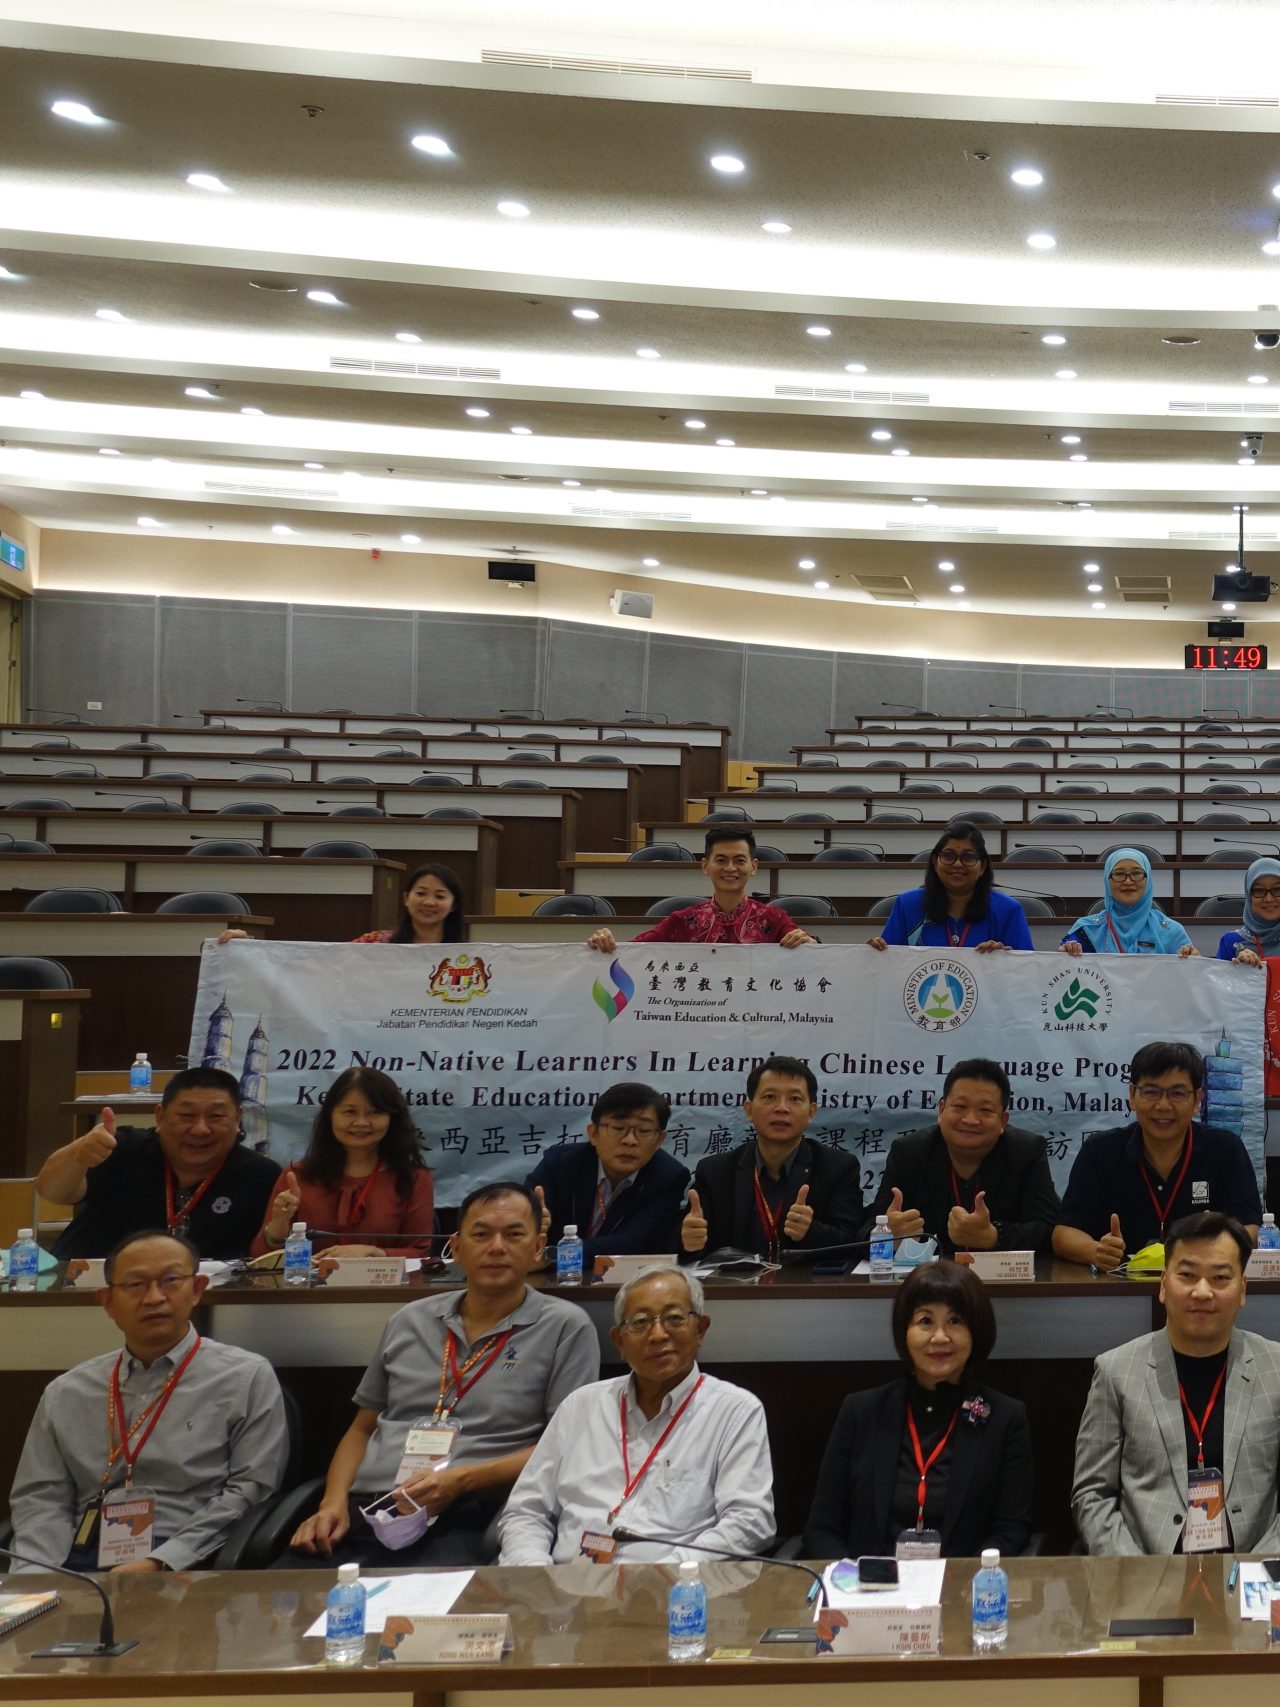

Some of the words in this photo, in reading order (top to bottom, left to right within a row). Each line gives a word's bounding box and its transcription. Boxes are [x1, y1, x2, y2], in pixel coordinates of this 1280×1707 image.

[1193, 647, 1261, 668] 11:49
[906, 965, 929, 1015] MINISTRY
[930, 962, 945, 972] OF
[947, 963, 975, 1017] EDUCATION
[1041, 992, 1049, 1015] KUN
[1048, 968, 1071, 988] SHAN
[1077, 967, 1113, 1016] UNIVERSITY
[390, 1008, 465, 1017] KEMENTERIAN
[647, 996, 662, 1006] The
[663, 996, 717, 1008] Organization
[717, 997, 729, 1007] of
[376, 1018, 417, 1029] Jabatan
[506, 1018, 538, 1029] Kedah
[633, 1010, 672, 1022] Taiwan
[674, 1011, 727, 1023] Education
[728, 1012, 740, 1023] &
[742, 1012, 786, 1024] Cultural,
[788, 1012, 834, 1026] Malaysia
[917, 1014, 961, 1031] 教育部
[1268, 1009, 1279, 1034] KUN
[276, 1048, 338, 1071] 2022
[350, 1049, 505, 1073] Non-Native
[515, 1050, 638, 1072] Learners
[648, 1050, 677, 1072] In
[819, 1052, 925, 1075] Chinese
[935, 1054, 1065, 1083] Luage
[401, 1086, 455, 1107] tate
[472, 1086, 600, 1107] Education
[886, 1089, 913, 1110] of
